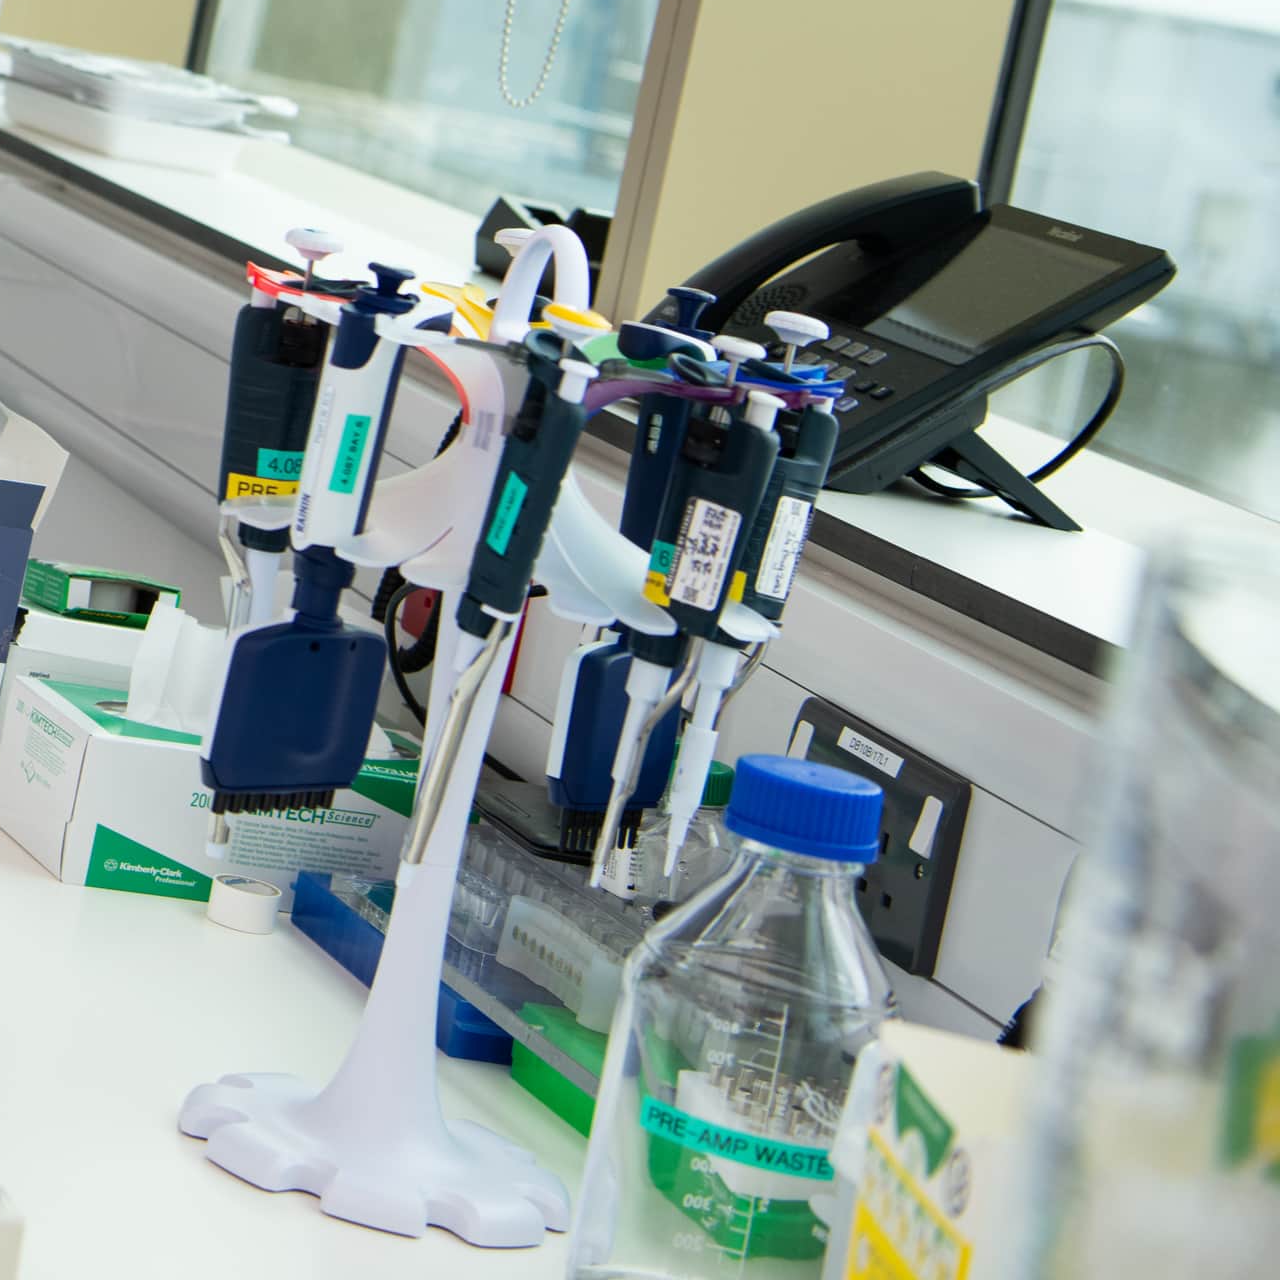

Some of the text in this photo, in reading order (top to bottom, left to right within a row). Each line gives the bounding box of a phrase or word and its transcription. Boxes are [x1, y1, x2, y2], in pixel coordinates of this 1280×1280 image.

[295, 493, 311, 532] RAININ
[327, 810, 371, 826] Science
[119, 861, 182, 879] Kimberly-Clark
[647, 1105, 831, 1176] PRE-AMP WASTE
